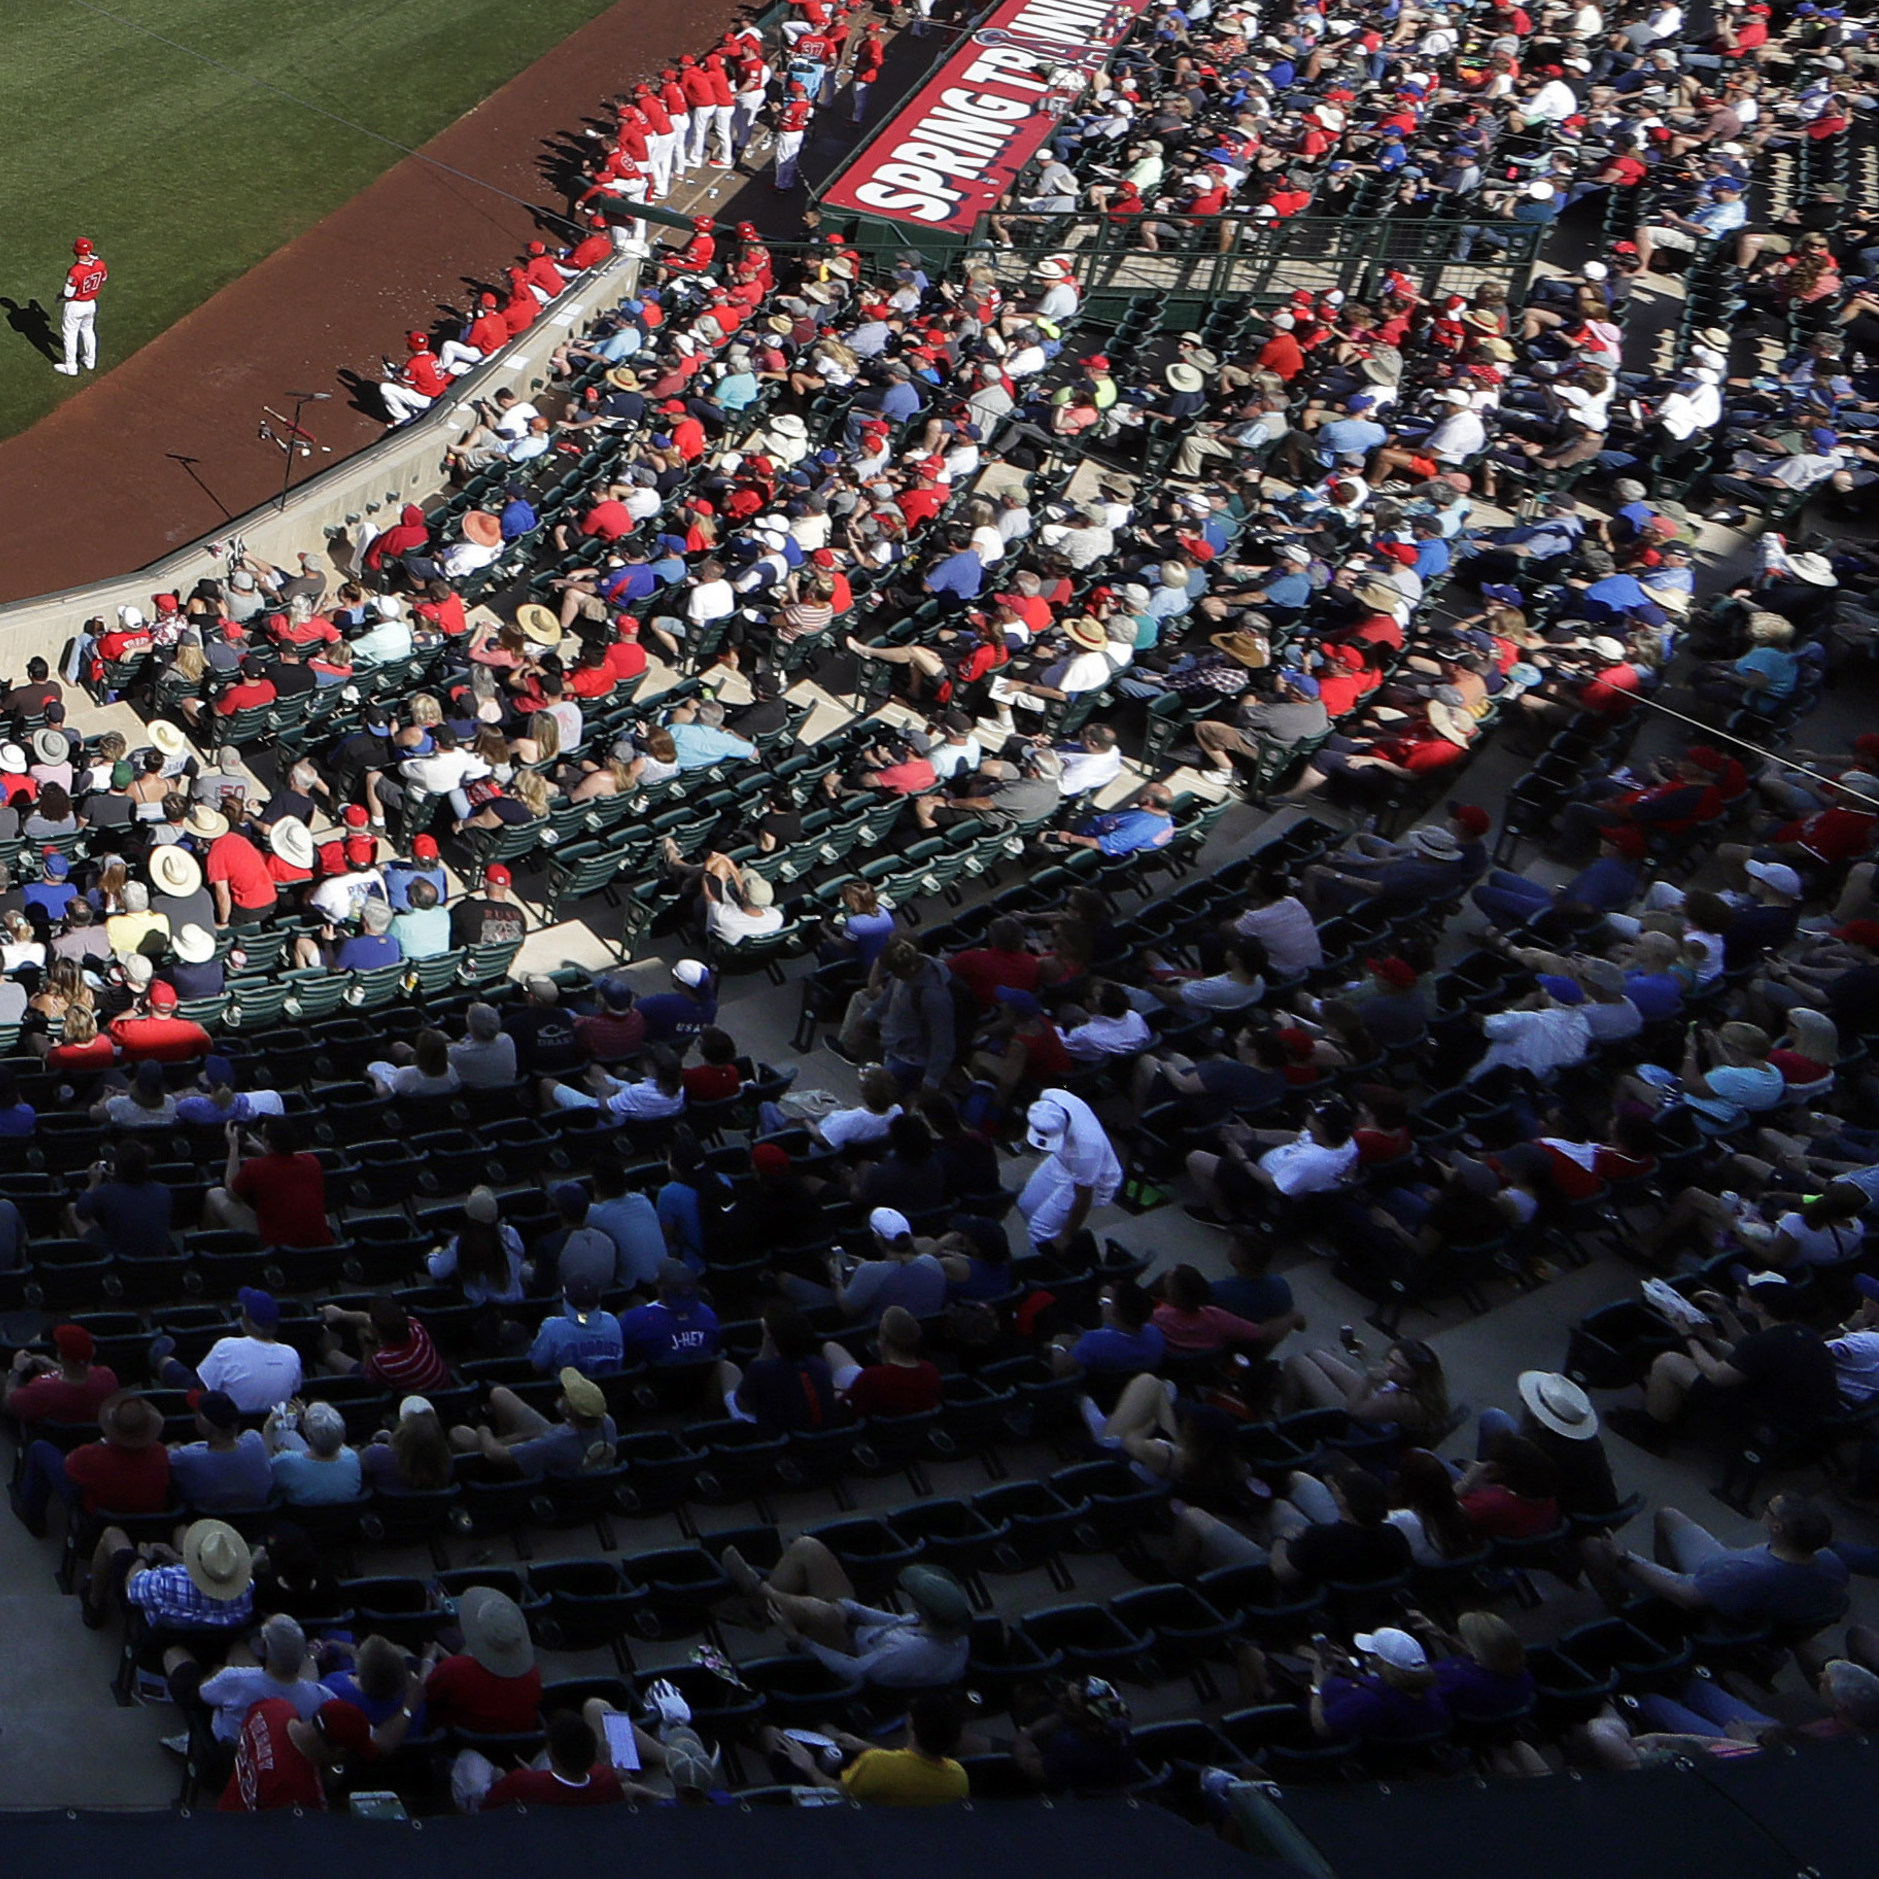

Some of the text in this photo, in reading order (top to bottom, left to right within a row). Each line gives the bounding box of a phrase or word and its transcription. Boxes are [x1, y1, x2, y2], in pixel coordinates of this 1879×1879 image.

[802, 41, 825, 57] 37
[854, 87, 1037, 222] SPRING
[83, 270, 103, 294] 27
[671, 1331, 704, 1350] J-HEY
